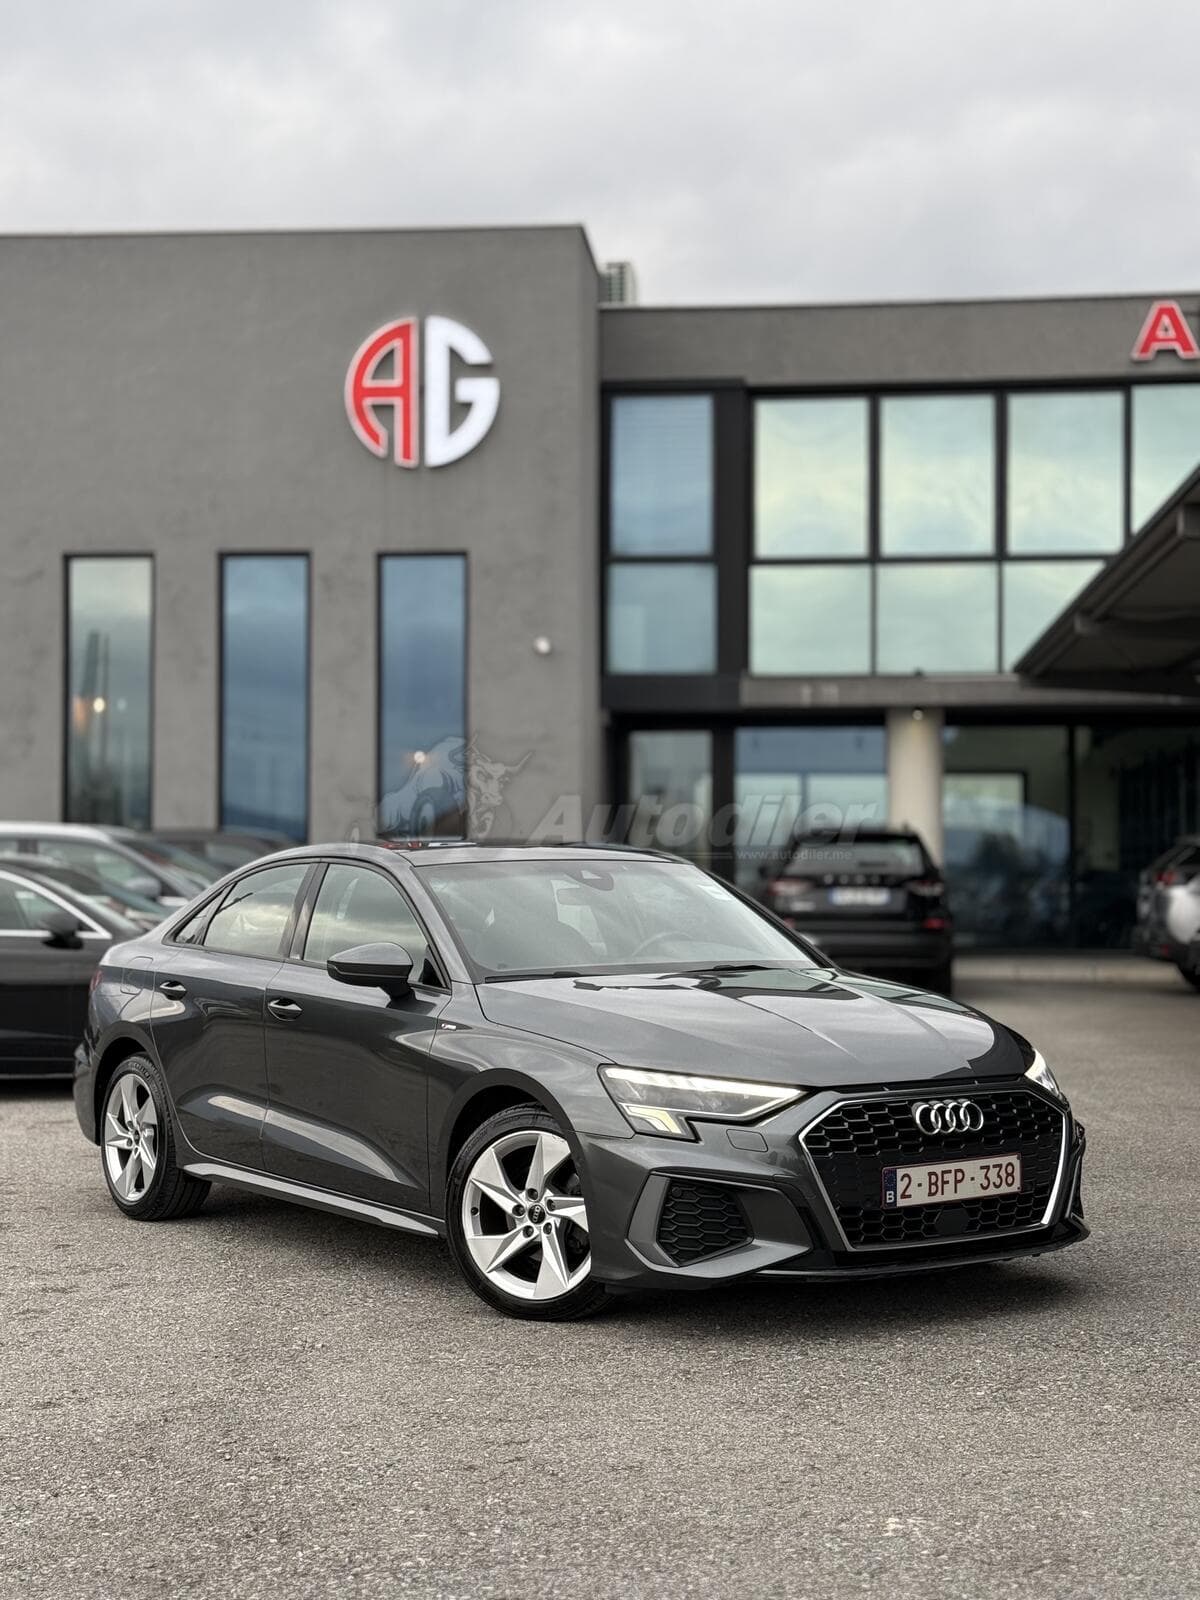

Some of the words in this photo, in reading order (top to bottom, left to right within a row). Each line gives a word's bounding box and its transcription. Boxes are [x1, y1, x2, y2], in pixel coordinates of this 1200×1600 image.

[344, 315, 501, 468] AG
[885, 1190, 895, 1204] B
[899, 1161, 1016, 1200] 2-BFP-338
